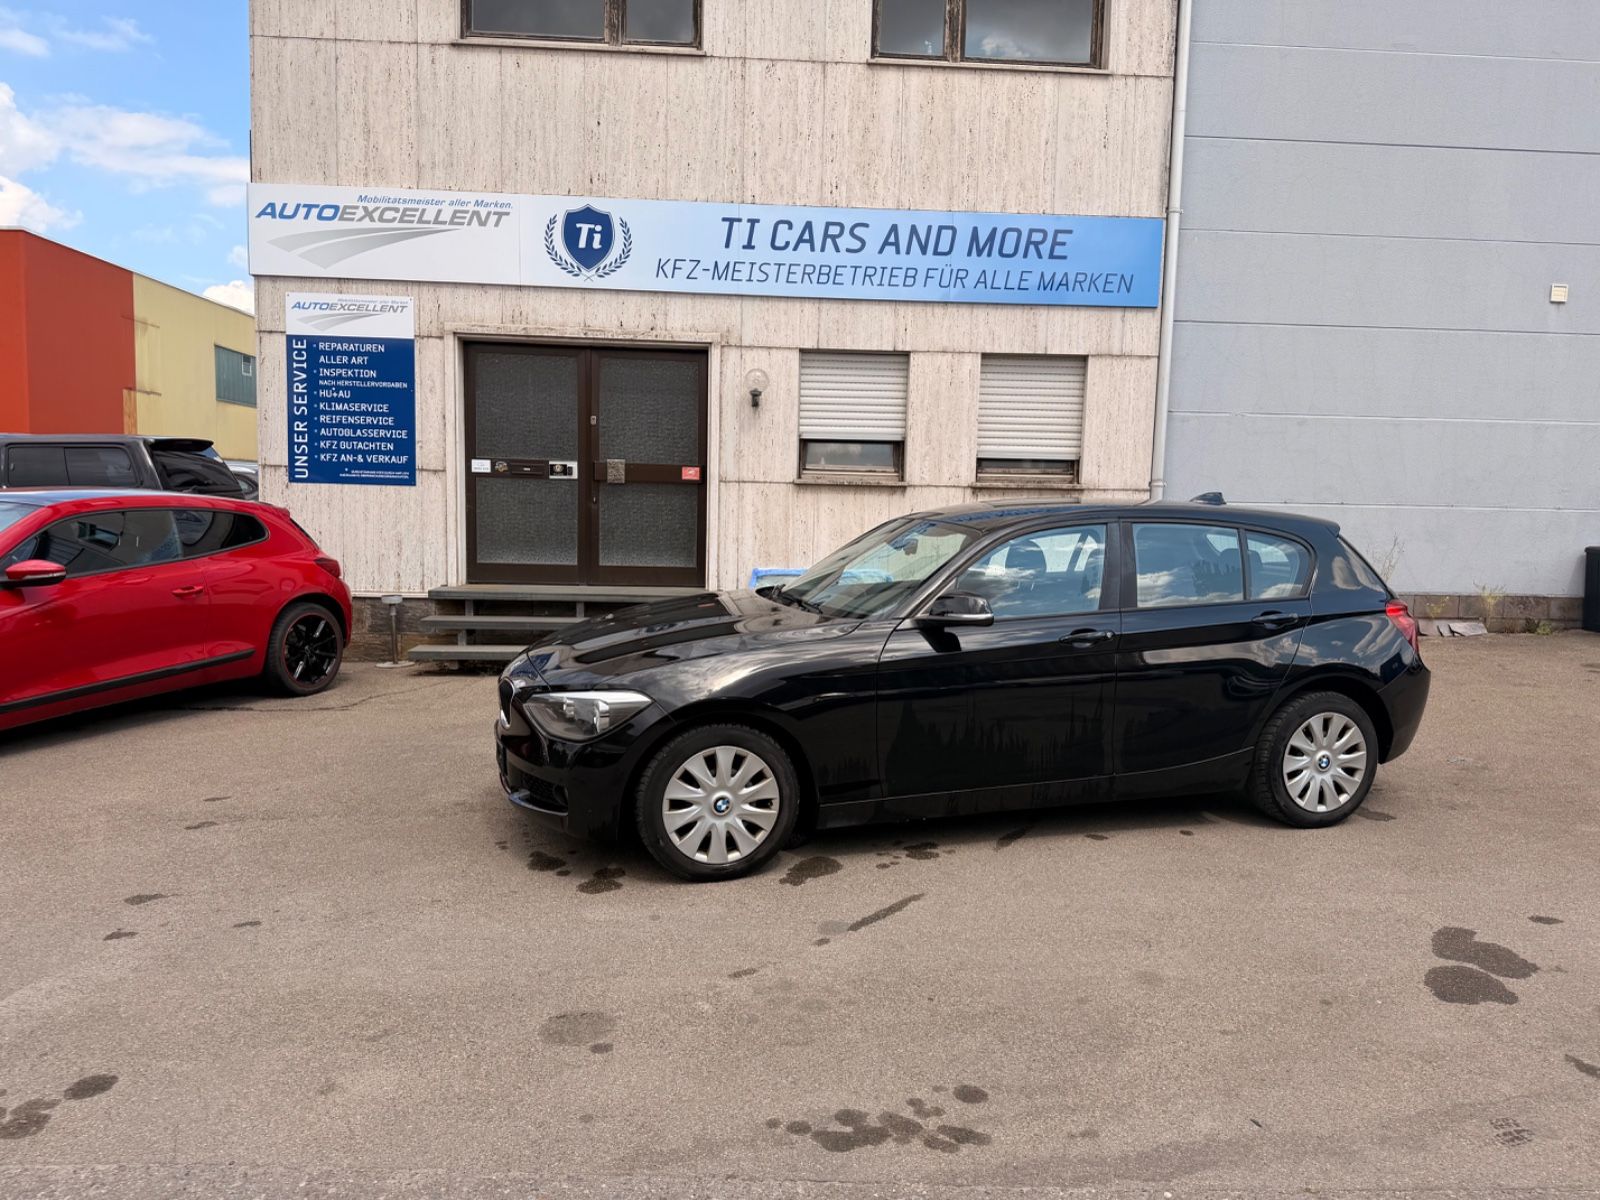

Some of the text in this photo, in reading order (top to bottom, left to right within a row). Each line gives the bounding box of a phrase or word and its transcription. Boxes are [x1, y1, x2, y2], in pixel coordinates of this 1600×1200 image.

[449, 199, 471, 207] aller
[255, 202, 511, 228] AUTOEXCELLENT
[575, 223, 603, 250] Ti
[721, 217, 1074, 260] TI CARS AND MORE
[655, 258, 1135, 294] KFZ-MEISTERBETRIEB FÜR ALLE MARKEN
[291, 301, 408, 313] AUTOEXCELLENT
[318, 342, 385, 353] REPARATUREN
[318, 355, 368, 365] ALLER ART
[319, 368, 377, 378] INSPEKTION
[293, 338, 308, 479] UNSER SERVICE
[319, 402, 389, 413] KLIMASERVICE
[319, 415, 395, 426] REIFENSERVICE
[320, 428, 408, 439] AUTOGLASSERVICE
[320, 440, 394, 451] KFZ GUTACHTEN
[320, 453, 338, 462] KFZ
[366, 455, 409, 464] VERKAUF
